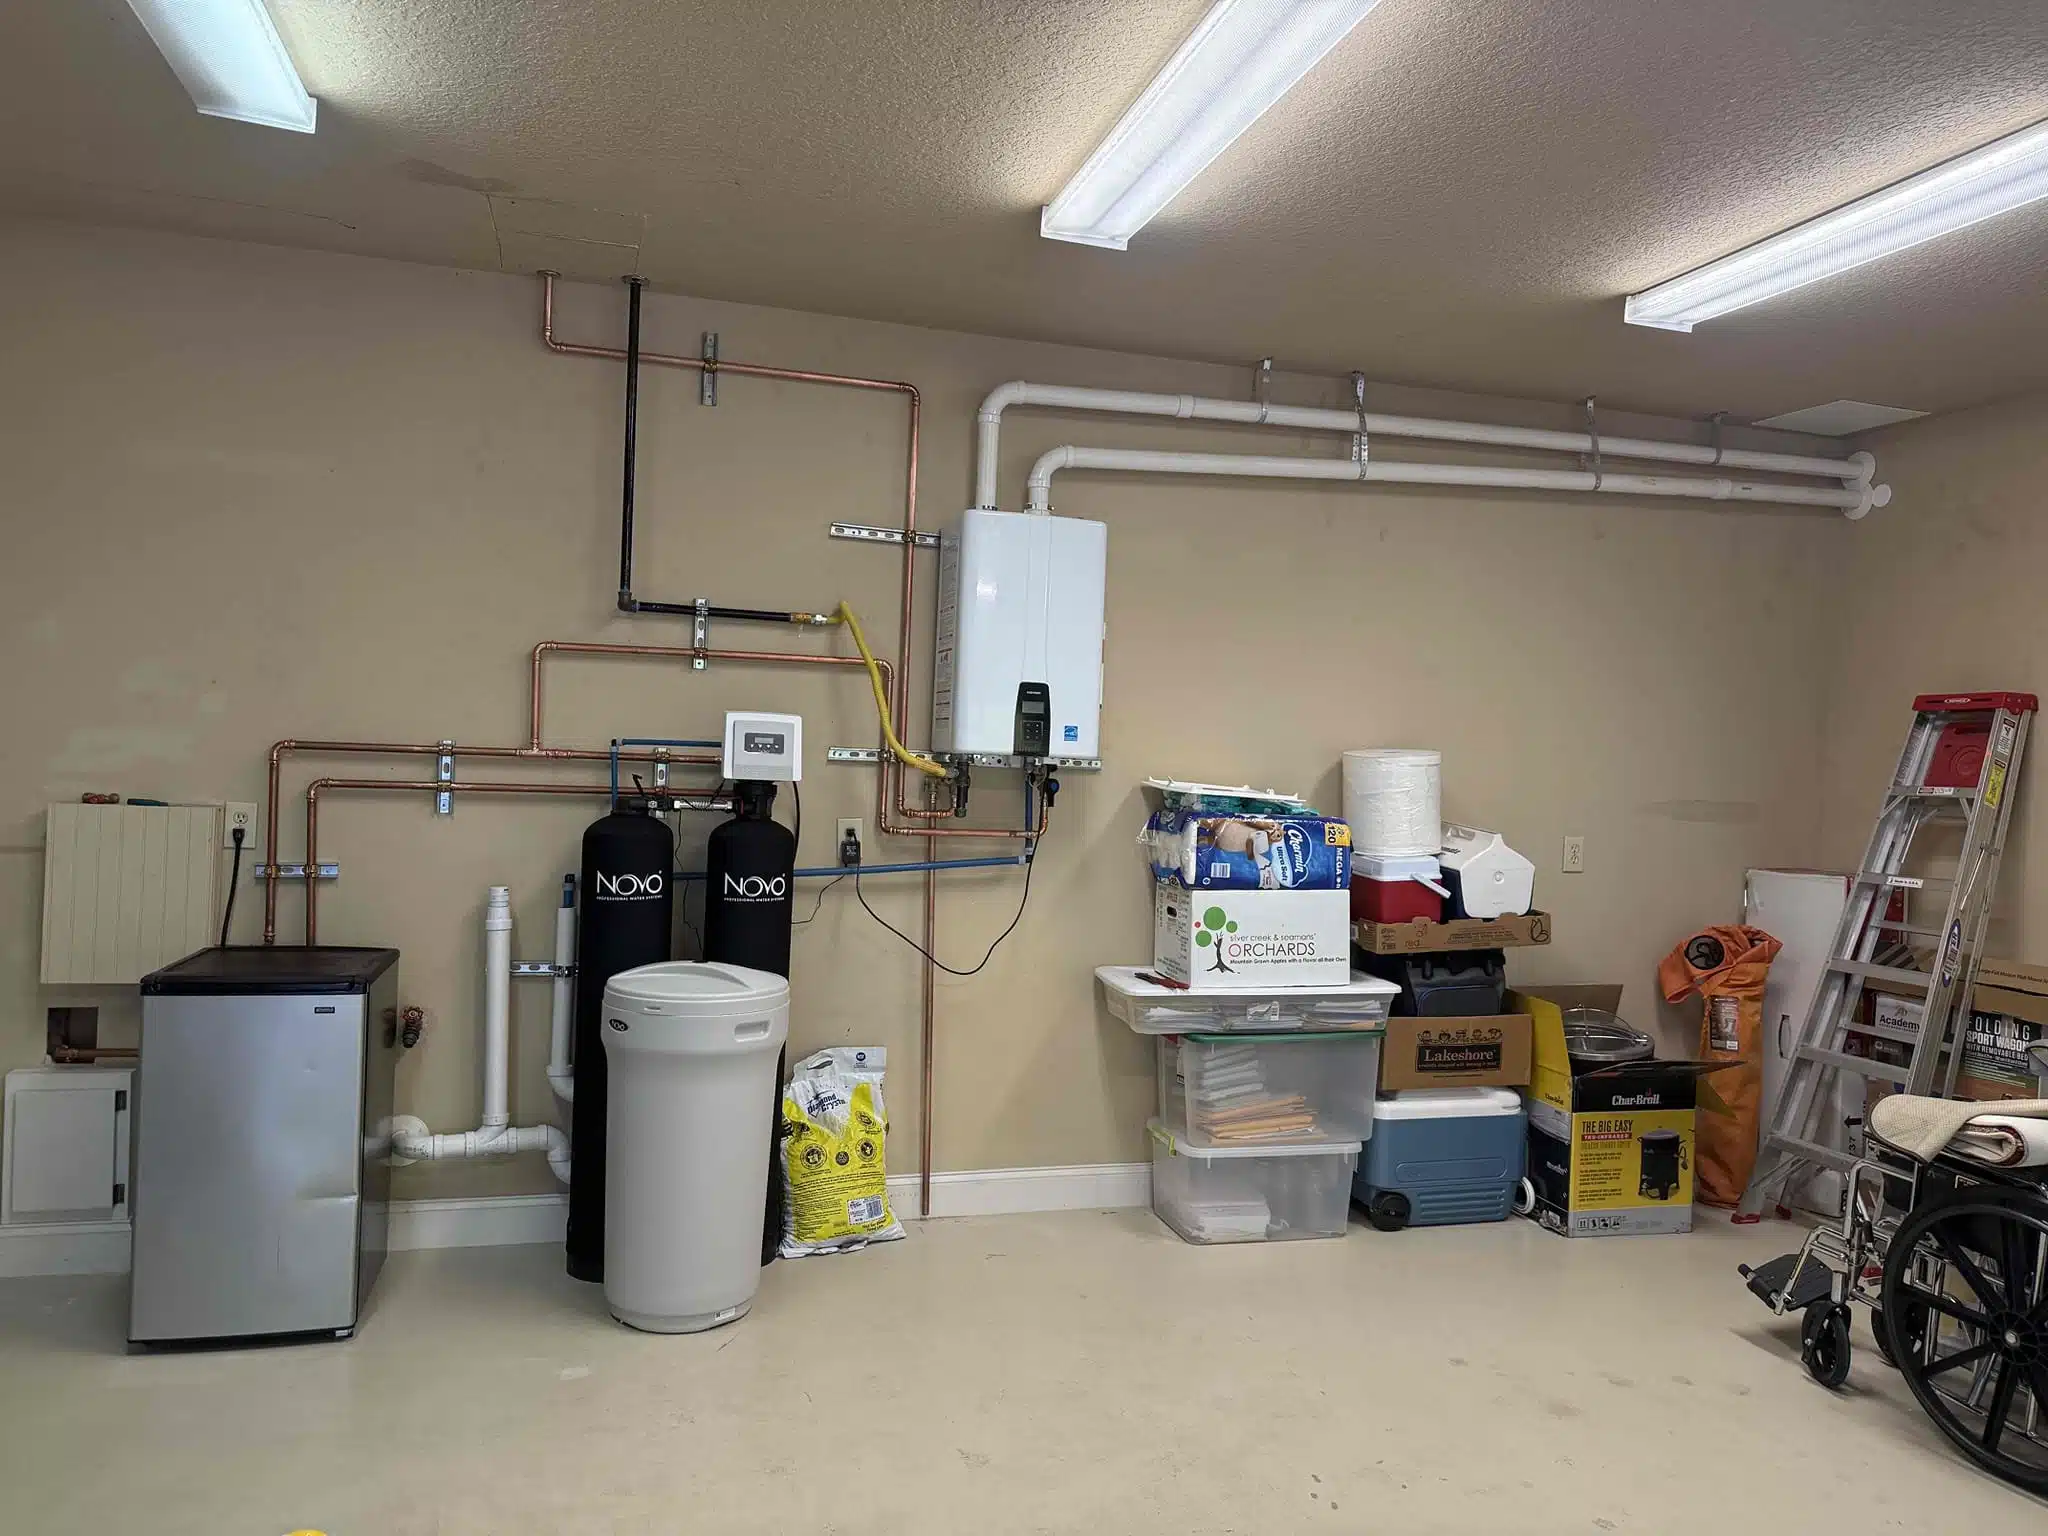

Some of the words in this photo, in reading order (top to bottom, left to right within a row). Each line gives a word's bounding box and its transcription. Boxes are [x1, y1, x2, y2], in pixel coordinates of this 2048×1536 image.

[1327, 826, 1337, 844] 120
[1276, 846, 1285, 865] Ultra
[1287, 829, 1304, 873] Charmin
[1335, 847, 1343, 875] MEGA
[596, 870, 663, 895] NOVO
[724, 872, 786, 897] NOVO
[1230, 934, 1249, 942] silver
[1228, 942, 1316, 957] ORCHARDS
[1966, 1030, 1995, 1046] SPORT
[1424, 1048, 1494, 1062] Lakeshore
[1982, 1045, 2016, 1059] REMOVABLE
[2017, 1051, 2029, 1060] BED
[1612, 1094, 1660, 1106] Char-Broil
[1582, 1121, 1597, 1132] THE
[1598, 1120, 1612, 1132] BIG
[1614, 1119, 1634, 1132] EASY
